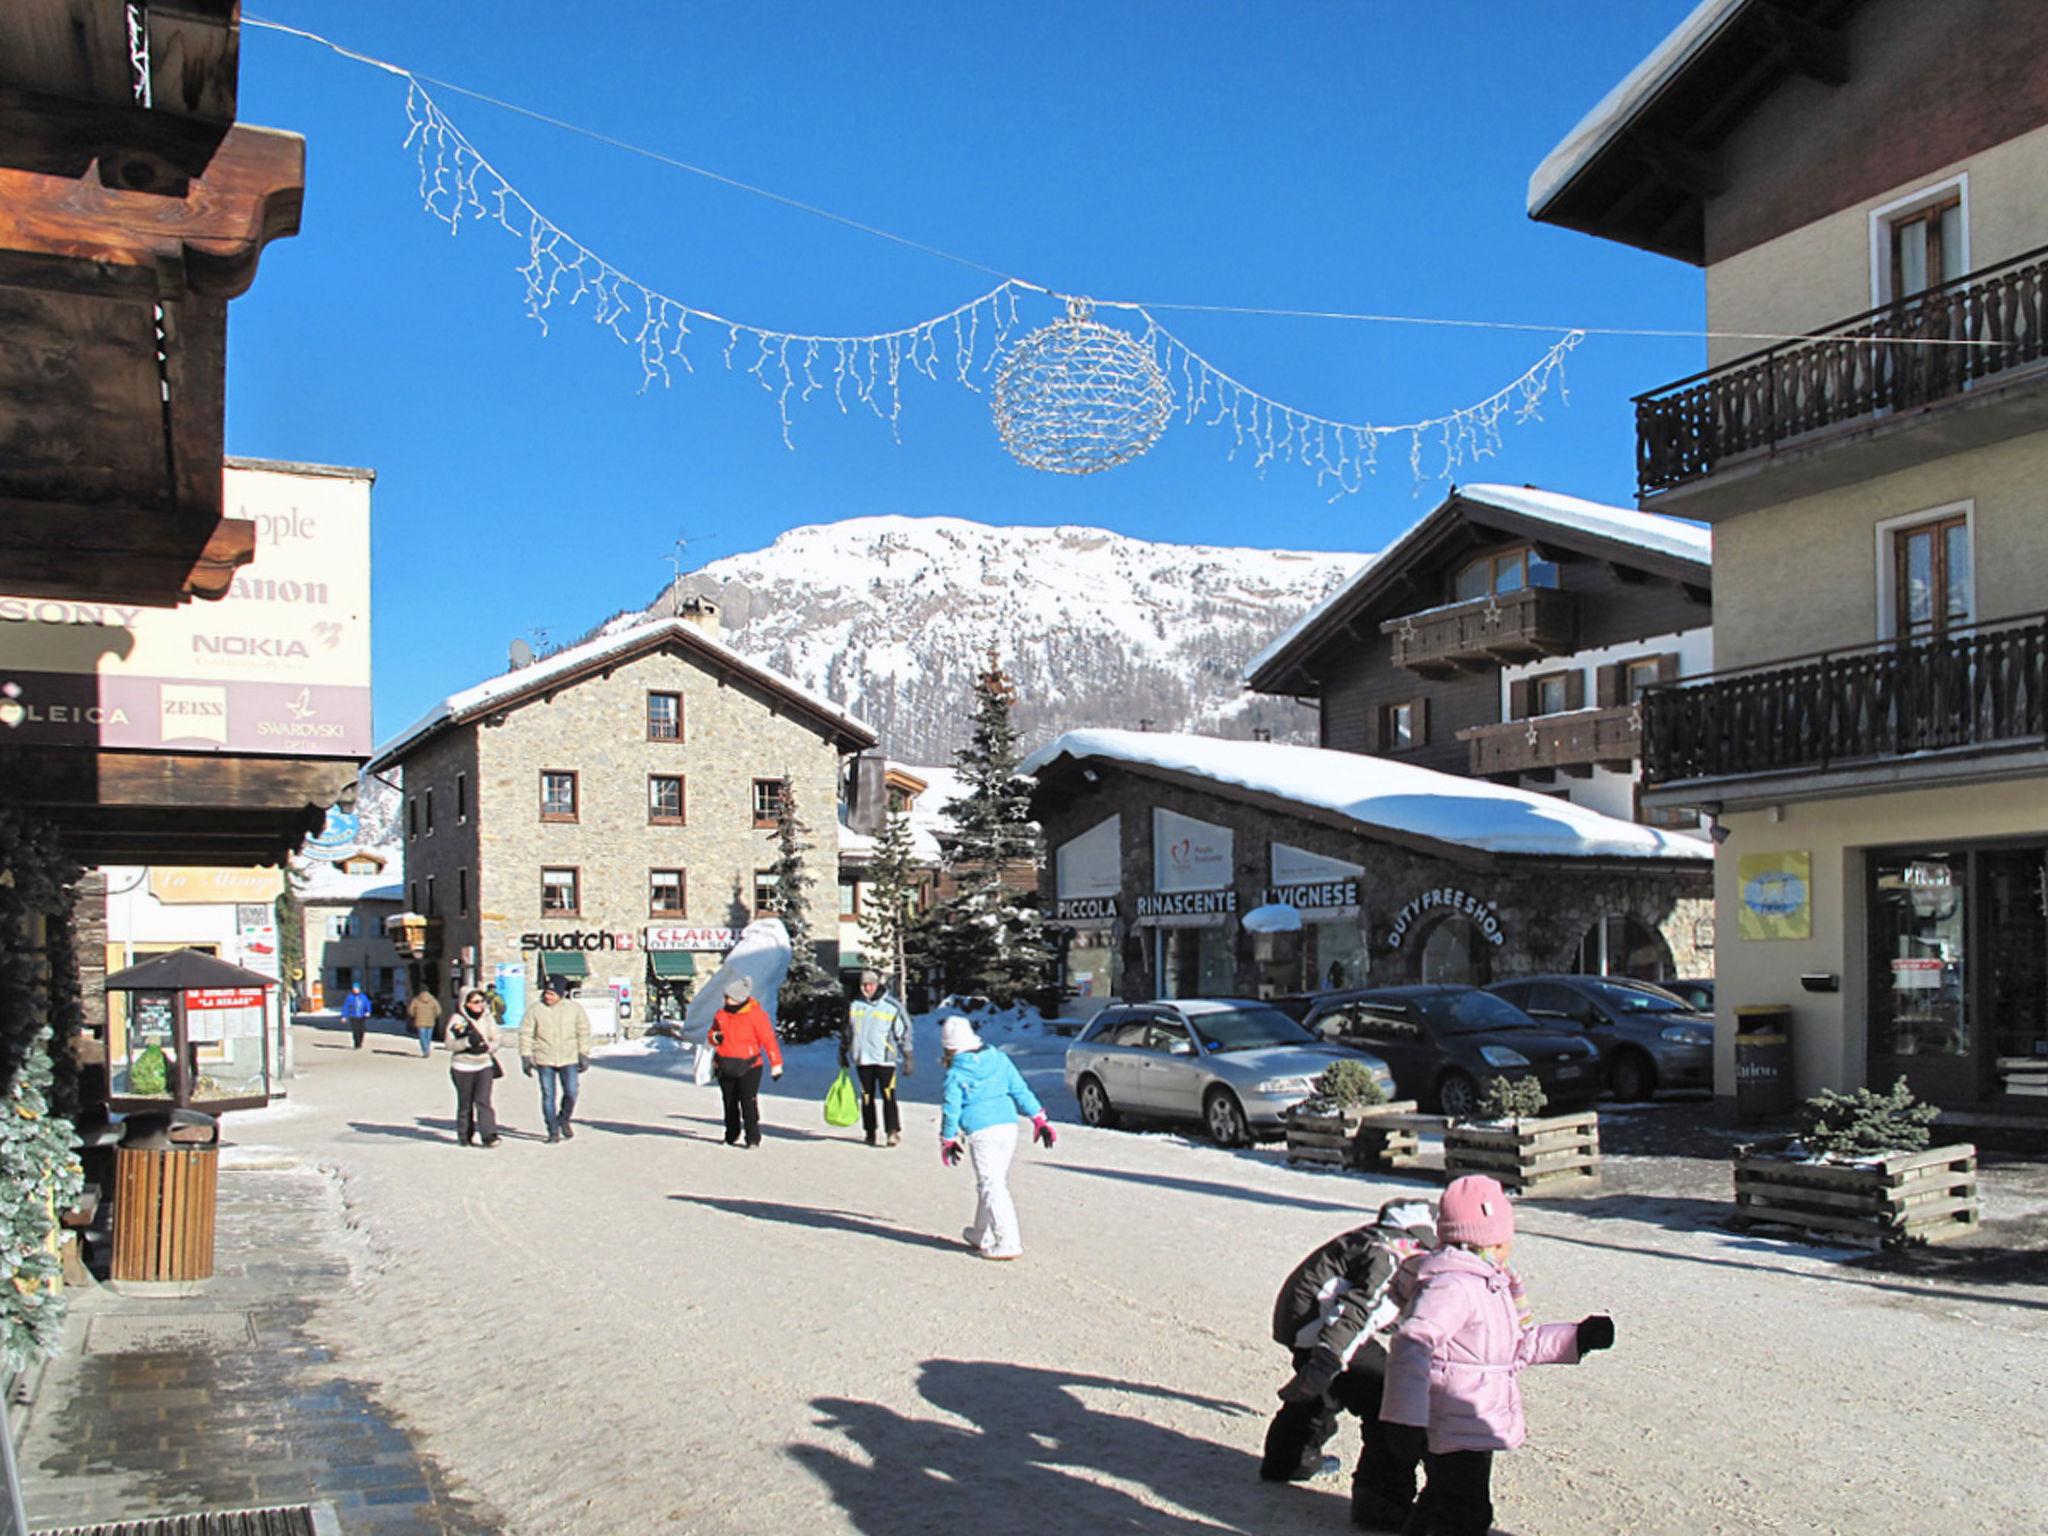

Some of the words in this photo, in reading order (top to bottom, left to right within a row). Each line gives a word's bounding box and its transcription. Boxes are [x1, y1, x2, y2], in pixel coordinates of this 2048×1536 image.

[229, 577, 329, 604] anon
[0, 600, 142, 629] SONY
[192, 634, 310, 659] NOKIA
[28, 704, 130, 724] LEICA
[164, 700, 224, 716] ZEISS
[257, 721, 345, 738] SWAROVSKI
[1057, 899, 1118, 918] PICCOLA
[1137, 892, 1237, 915] RINASCENTE
[1388, 897, 1420, 947] DUTY
[1422, 887, 1465, 910] FREE
[1464, 897, 1504, 946] SHOP
[520, 928, 615, 951] swatch
